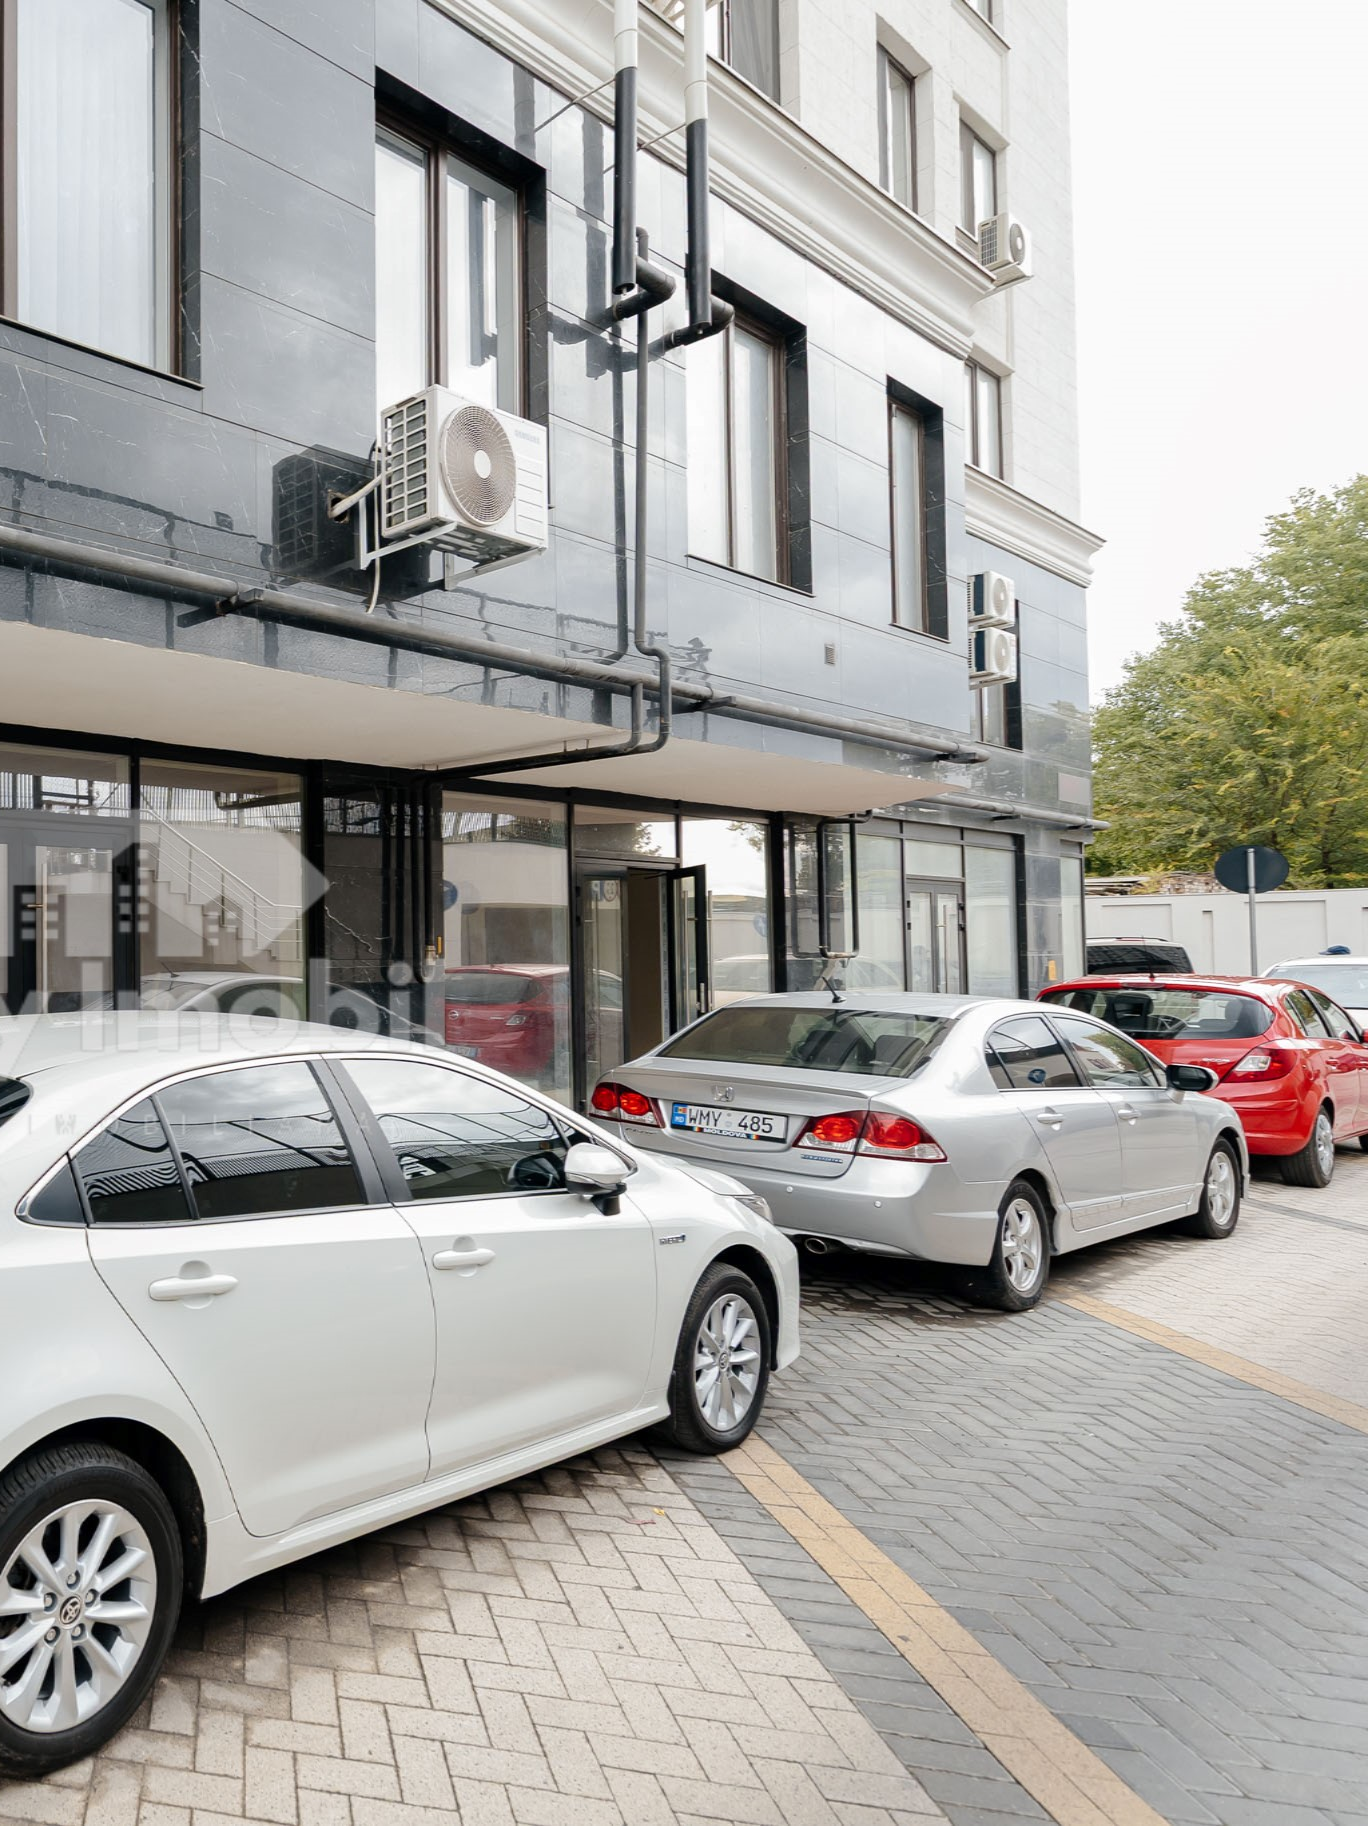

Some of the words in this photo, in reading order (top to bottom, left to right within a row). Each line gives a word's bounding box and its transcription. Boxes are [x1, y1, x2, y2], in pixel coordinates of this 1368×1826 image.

[689, 1108, 722, 1127] WMY
[738, 1114, 774, 1134] 485
[703, 1128, 748, 1139] MOLDOVA
